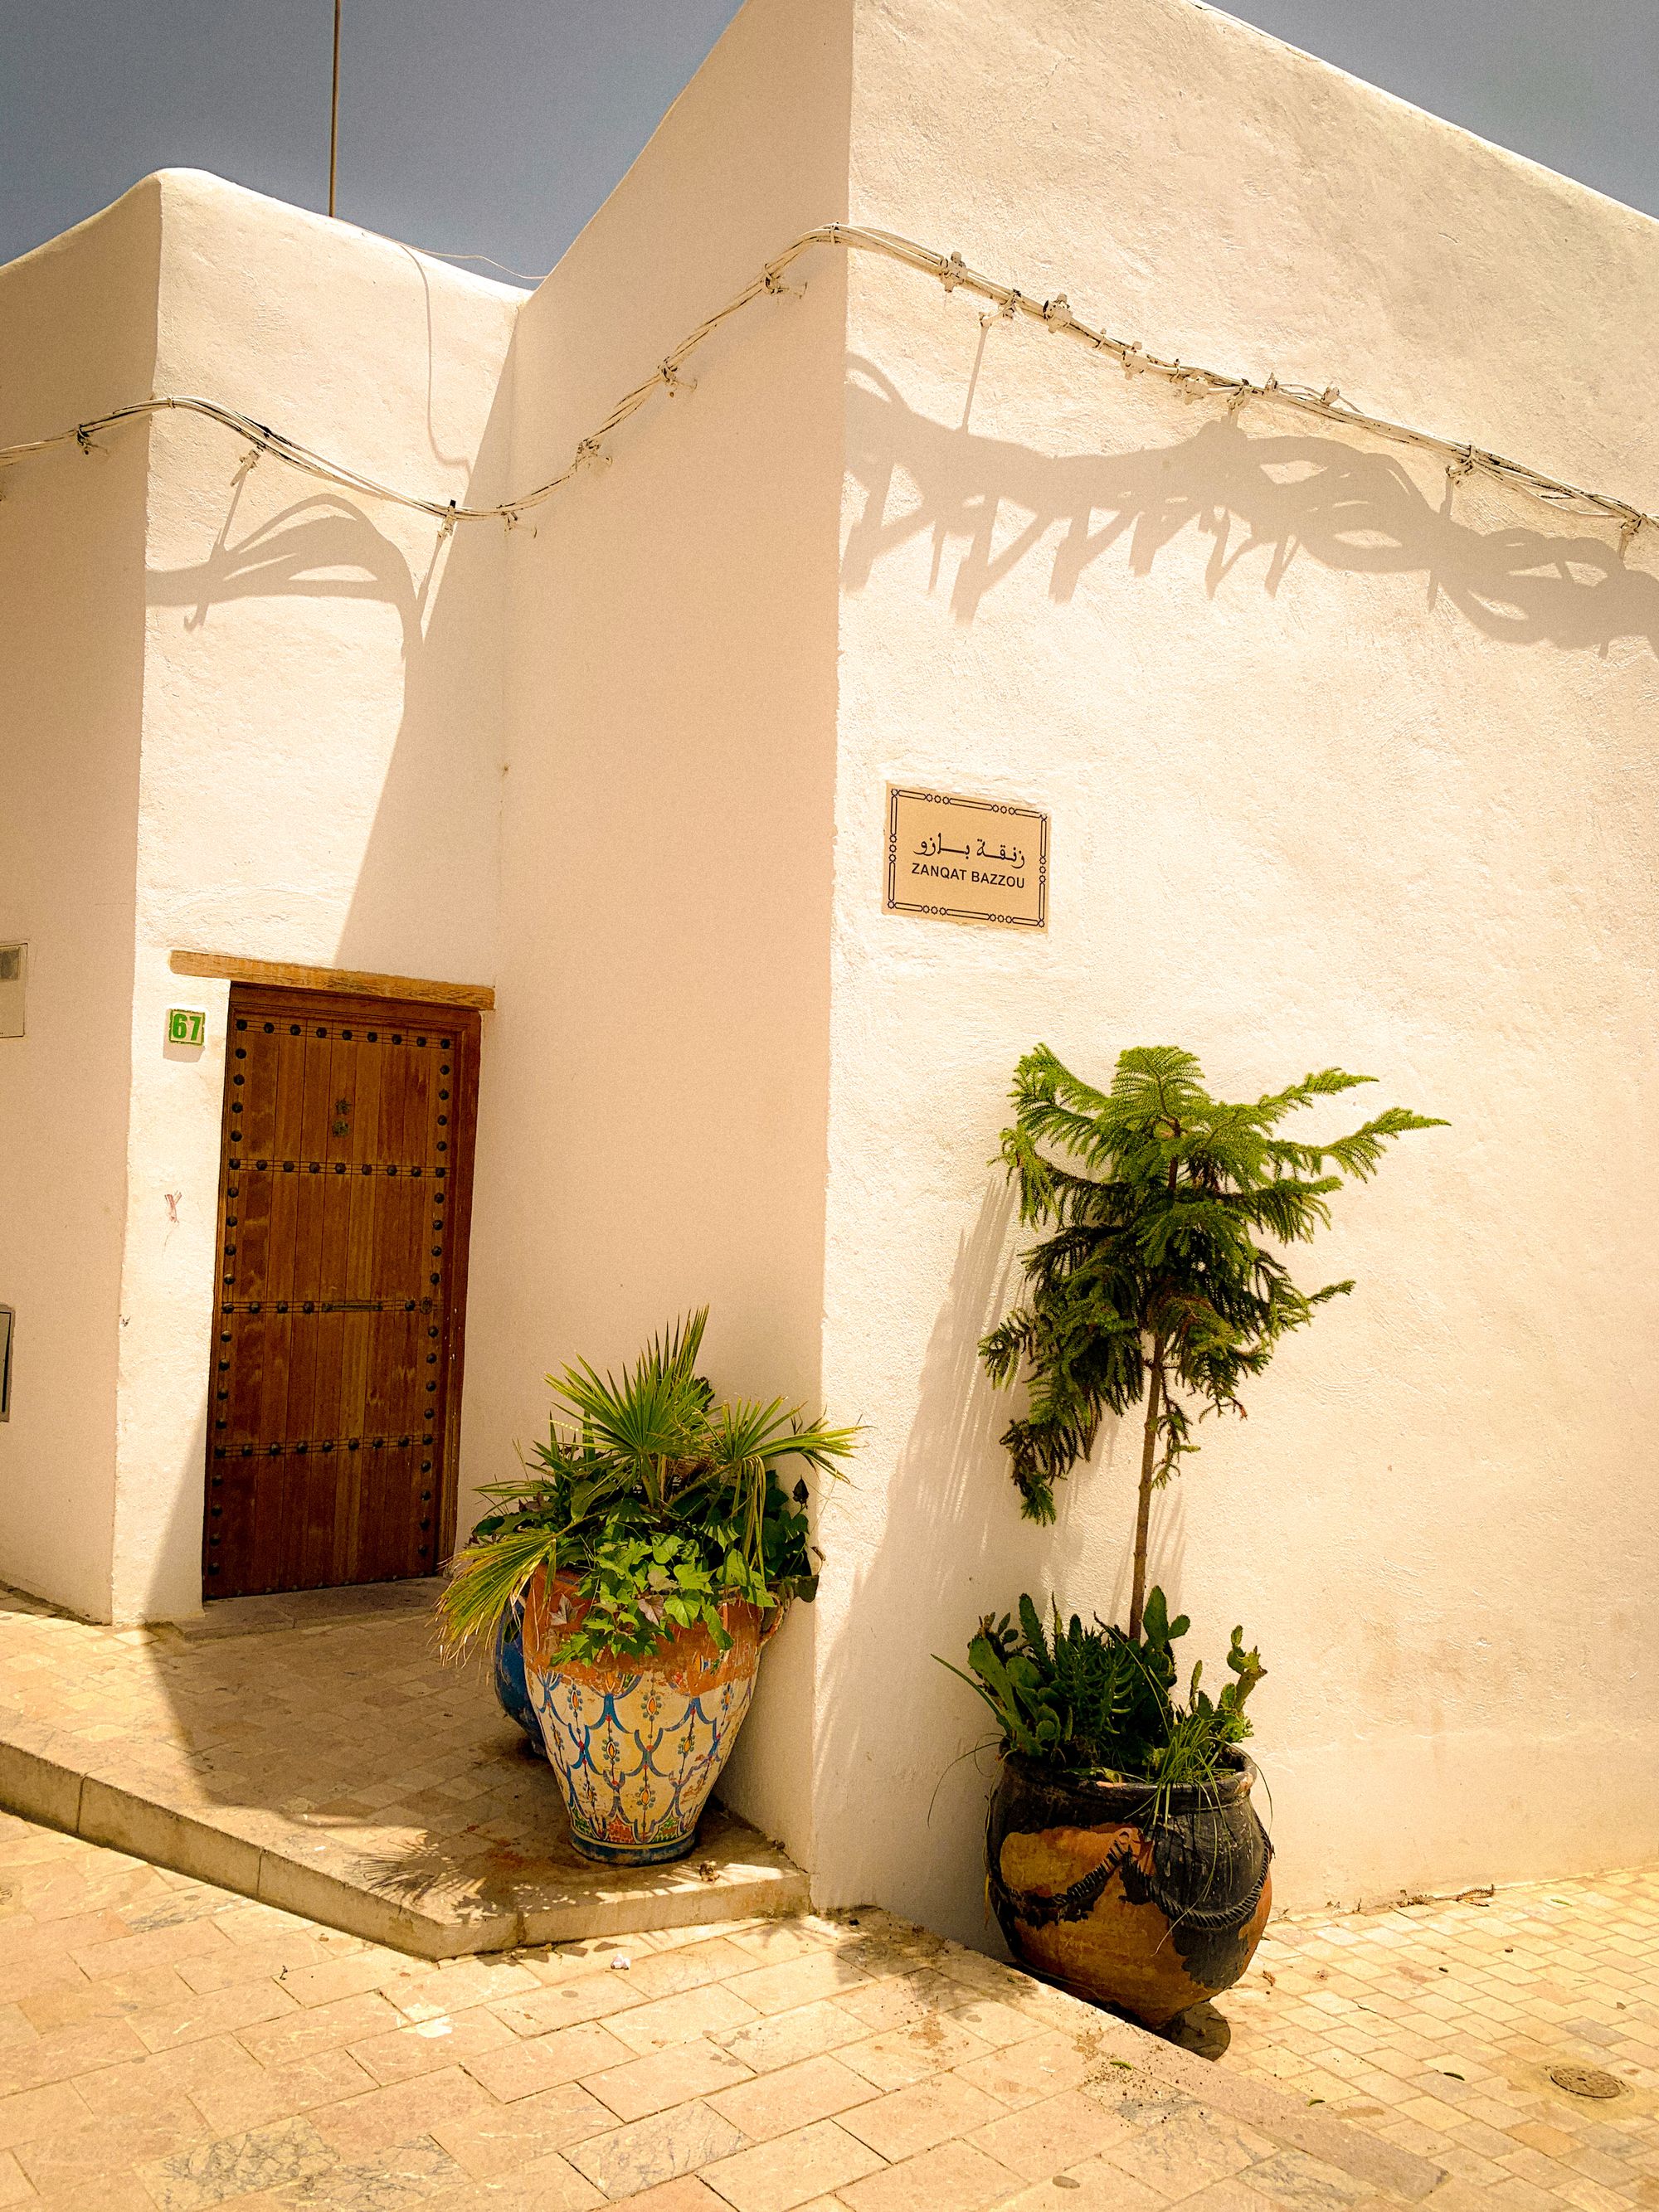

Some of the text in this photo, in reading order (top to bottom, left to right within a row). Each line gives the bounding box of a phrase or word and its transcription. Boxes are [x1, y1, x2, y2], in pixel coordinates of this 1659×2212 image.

[912, 832, 1025, 869] زنقة بازو
[912, 863, 1025, 888] ZANQAT BAZZOU
[173, 1014, 202, 1040] 67
